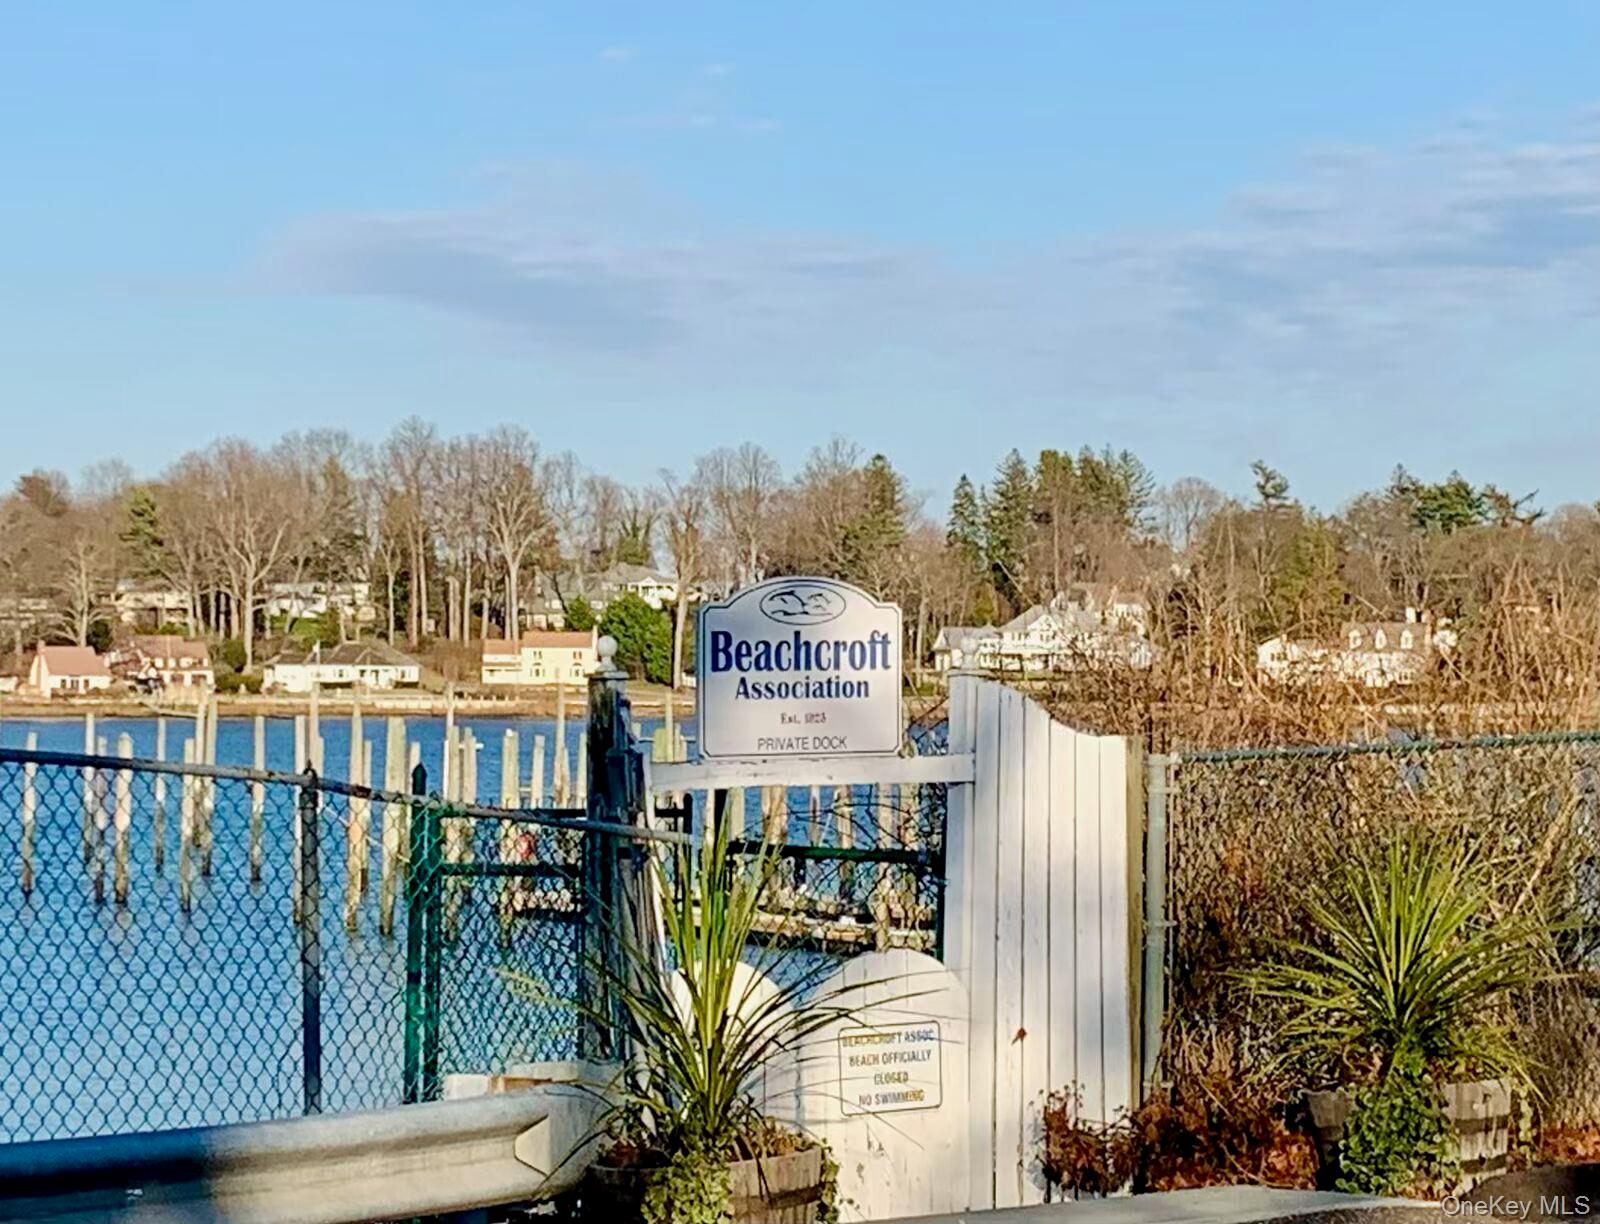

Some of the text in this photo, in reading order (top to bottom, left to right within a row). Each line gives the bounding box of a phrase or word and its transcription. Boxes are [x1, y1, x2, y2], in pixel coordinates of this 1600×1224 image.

[710, 629, 891, 673] Beachcroft
[735, 675, 869, 700] Association
[757, 735, 848, 751] PRIVATE DOCK
[849, 1049, 932, 1067] BEACH OFFICIALLY
[873, 1071, 909, 1085] CLOSED
[858, 1089, 925, 1106] NO SWIMMING
